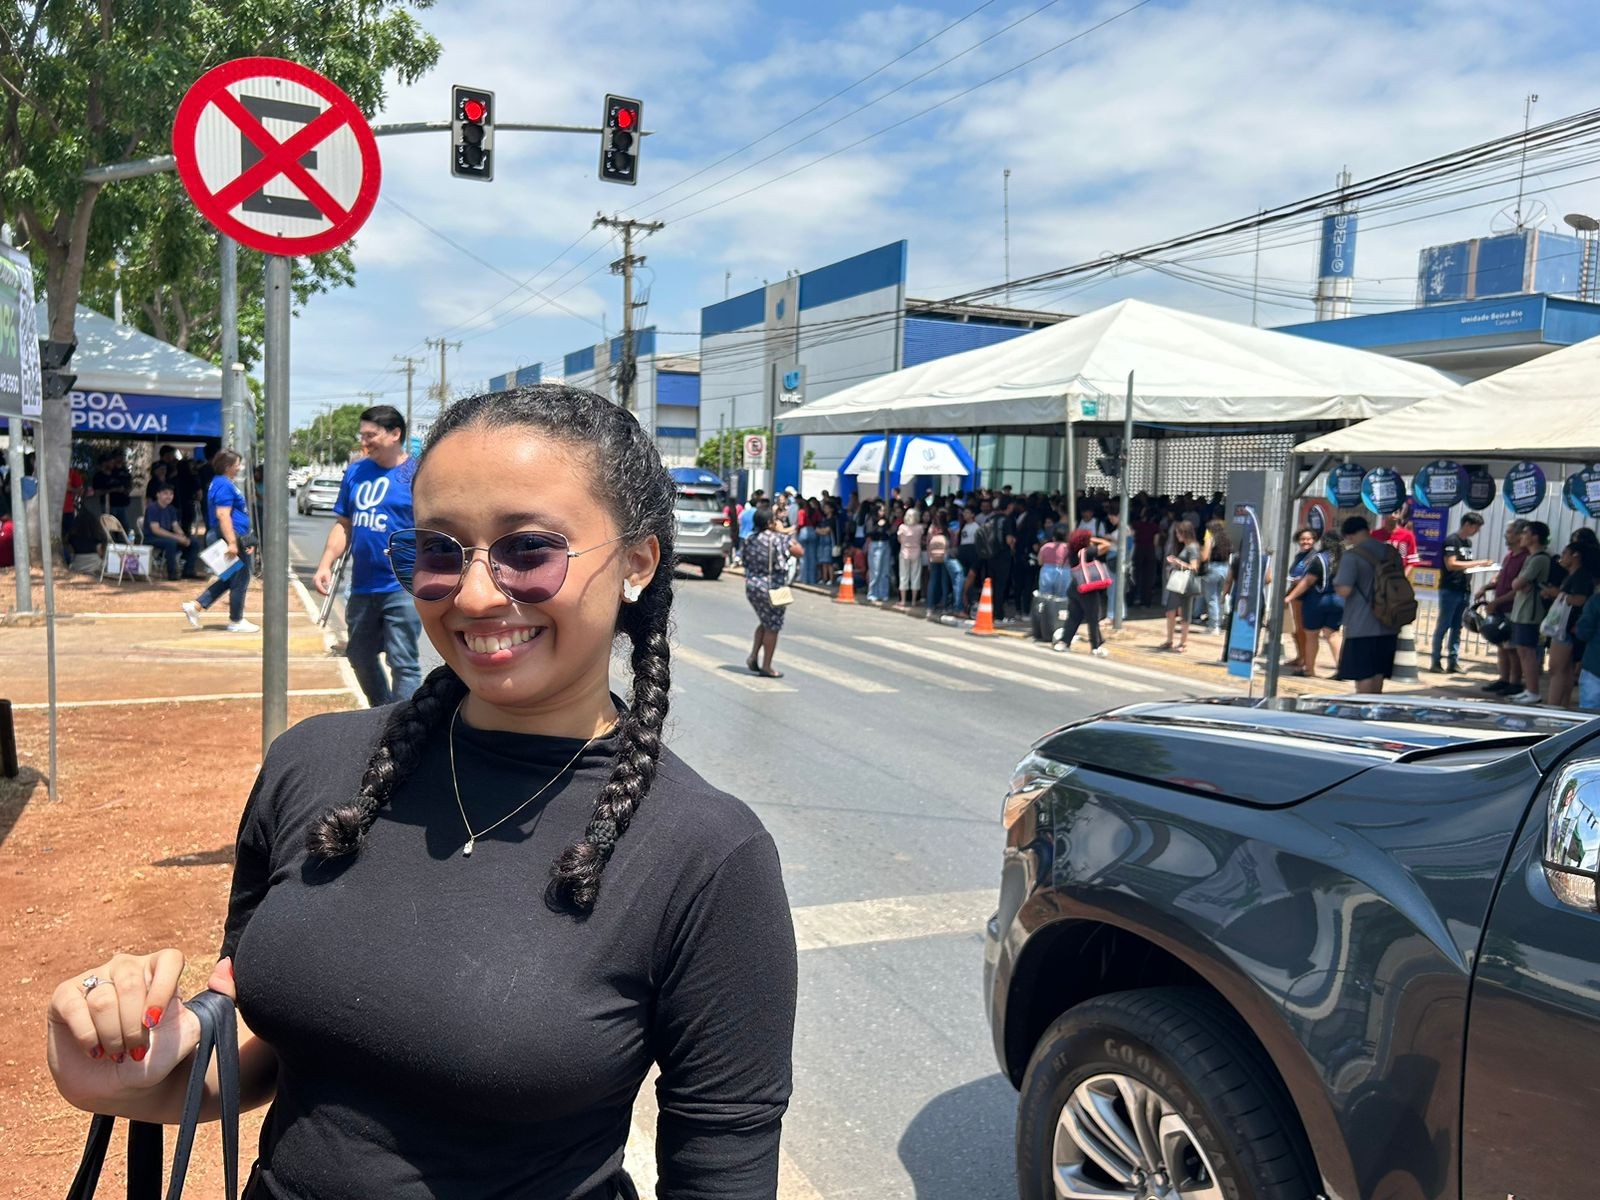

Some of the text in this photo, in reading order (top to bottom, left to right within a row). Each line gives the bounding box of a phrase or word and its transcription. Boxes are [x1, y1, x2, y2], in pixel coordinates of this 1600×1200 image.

[1460, 308, 1523, 325] Unidade Beira Rio
[69, 391, 128, 410] BOA
[779, 392, 802, 404] unic
[71, 410, 168, 433] PROVA!
[352, 507, 389, 530] unic
